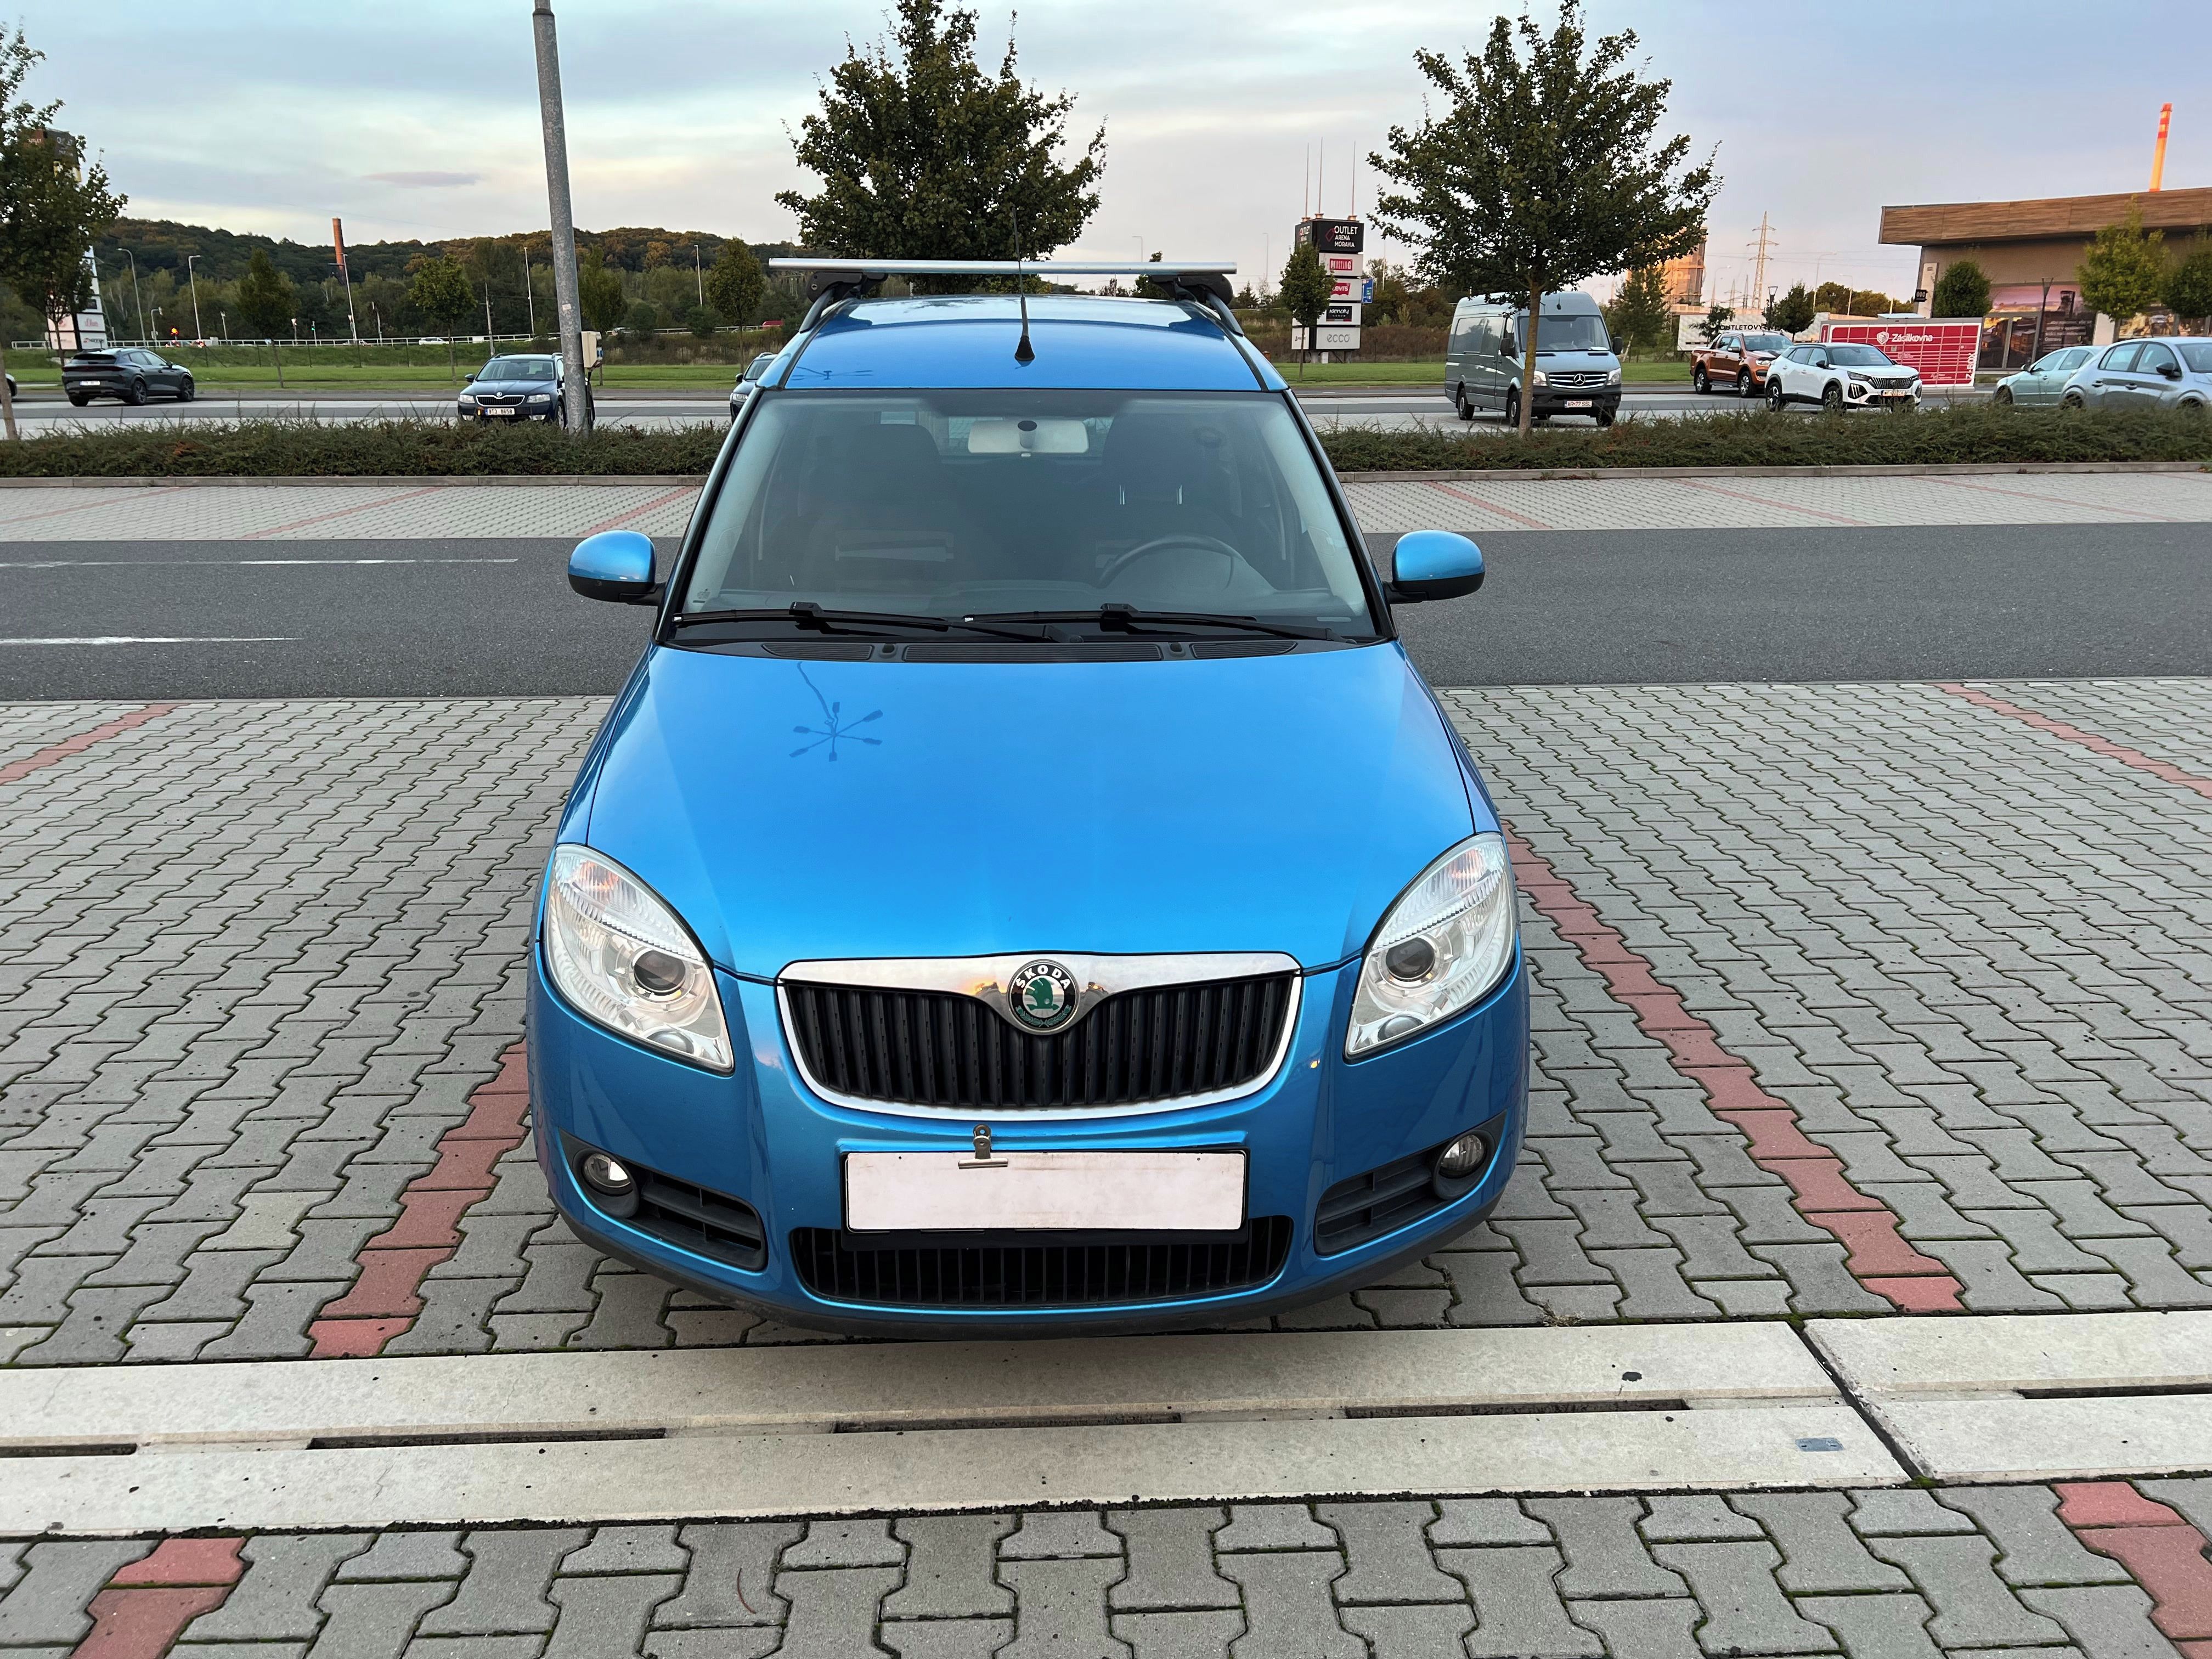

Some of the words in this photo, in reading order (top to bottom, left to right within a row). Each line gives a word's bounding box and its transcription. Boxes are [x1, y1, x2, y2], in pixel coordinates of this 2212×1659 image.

[1334, 225, 1358, 234] OUTLET
[1327, 334, 1350, 342] ecco
[1892, 333, 1933, 342] Zásilkovna
[1966, 352, 1976, 379] Z-BOX
